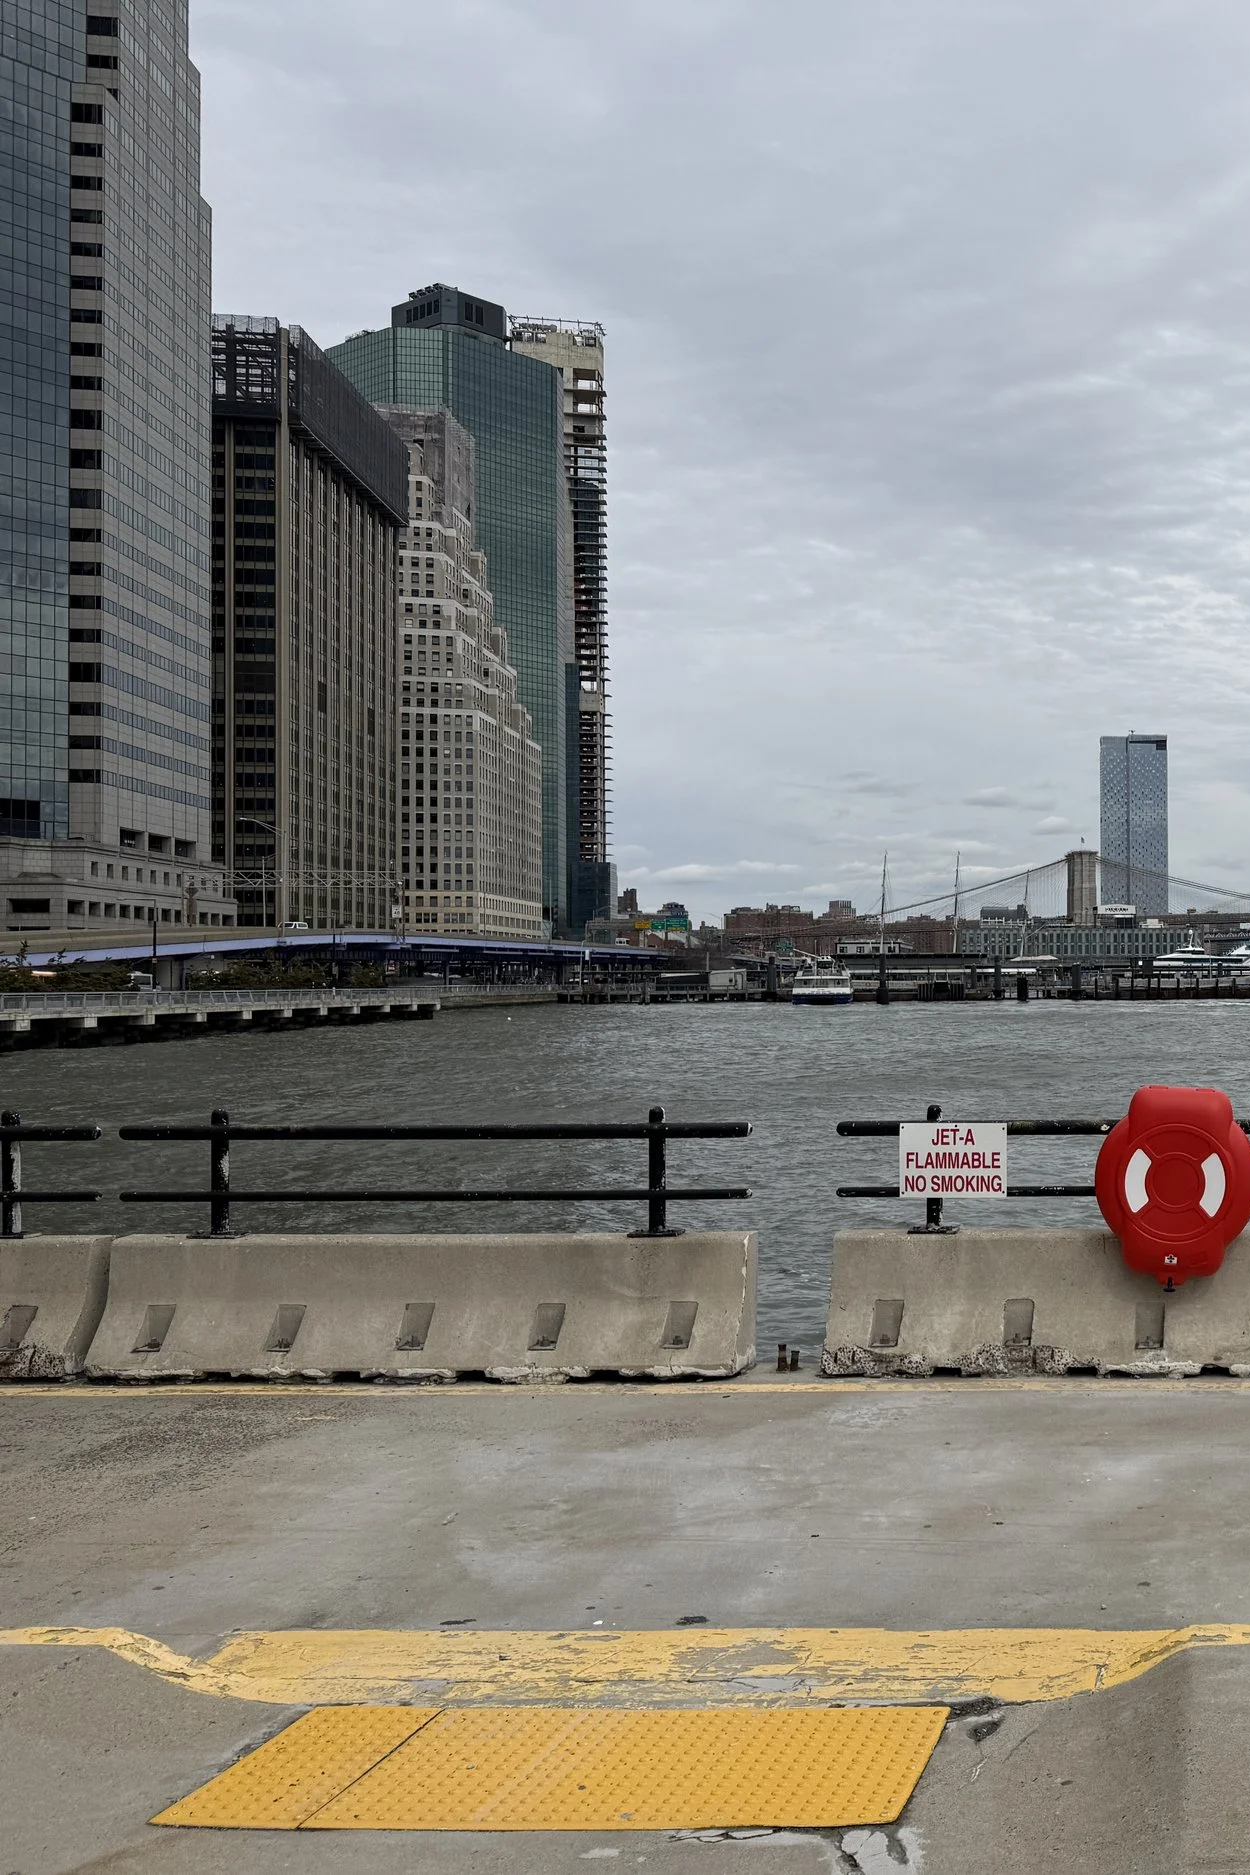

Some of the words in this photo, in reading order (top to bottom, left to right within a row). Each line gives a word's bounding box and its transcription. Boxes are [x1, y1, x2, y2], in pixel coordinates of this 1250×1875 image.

[931, 1128, 975, 1146] JET-A
[906, 1152, 1001, 1169] FLAMMABLE
[904, 1175, 927, 1193] NO
[931, 1175, 1002, 1193] SMOKING
